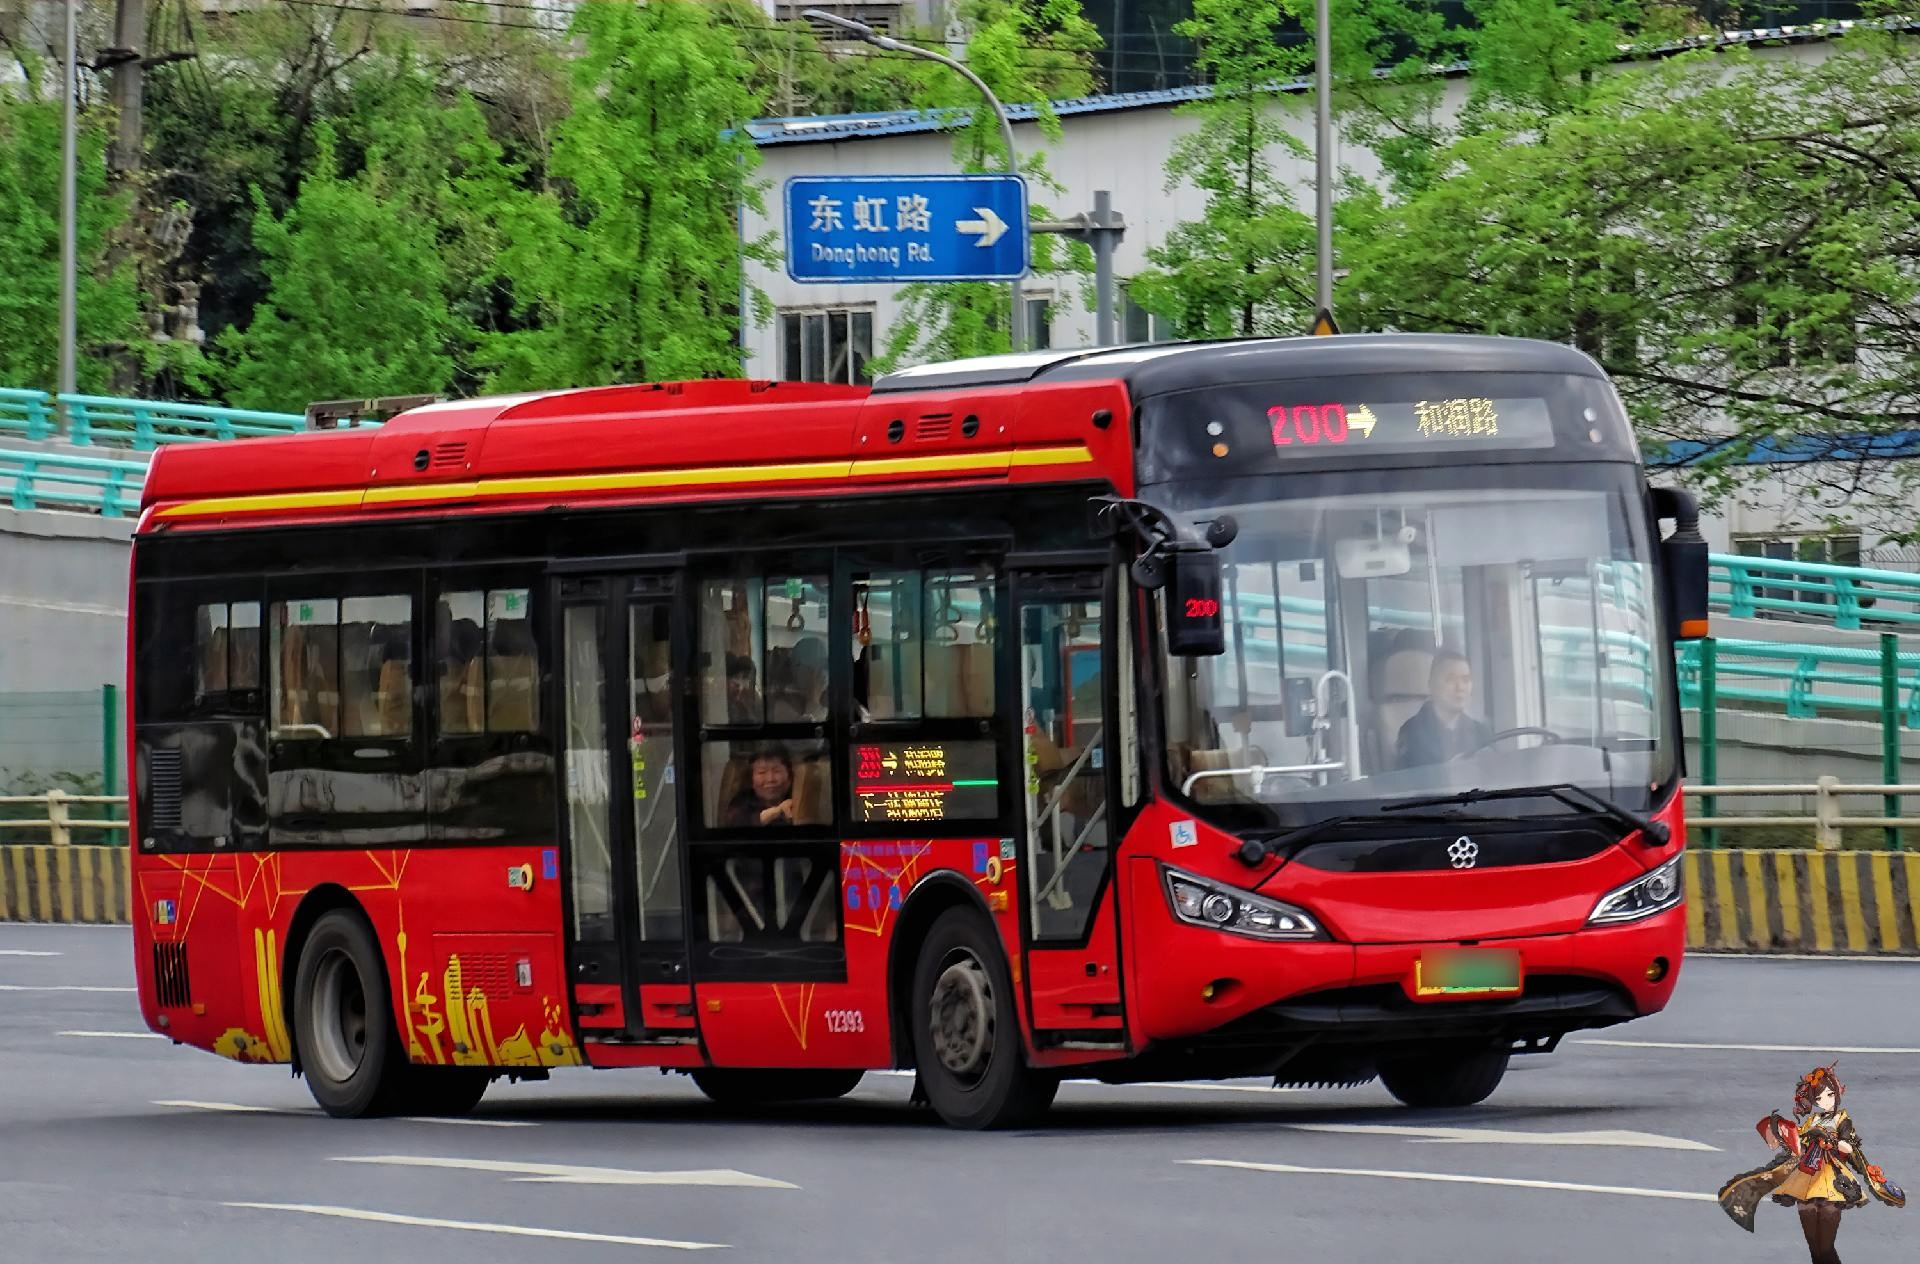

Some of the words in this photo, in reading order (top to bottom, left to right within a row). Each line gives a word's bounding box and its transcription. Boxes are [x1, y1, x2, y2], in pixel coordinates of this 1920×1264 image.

[808, 194, 933, 233] 东虹路
[811, 243, 900, 269] Donghong
[907, 242, 934, 262] Rd.
[1266, 404, 1349, 446] 200
[1185, 598, 1218, 617] 200
[824, 1010, 864, 1033] 12393
